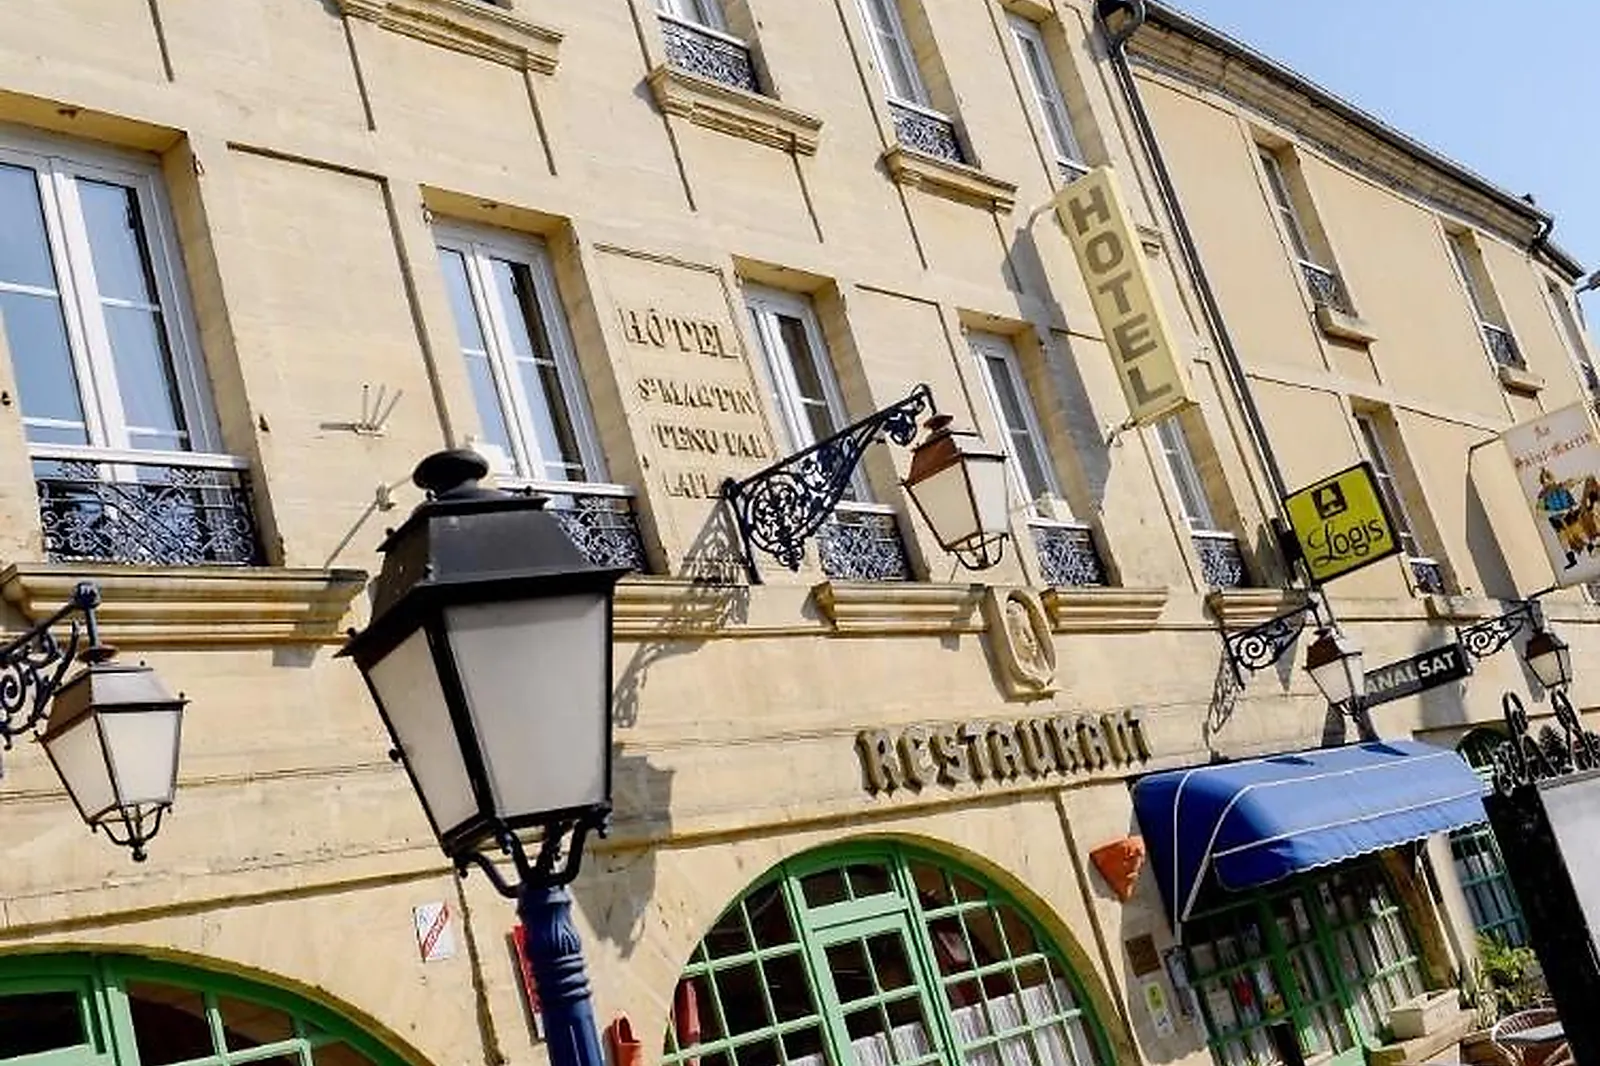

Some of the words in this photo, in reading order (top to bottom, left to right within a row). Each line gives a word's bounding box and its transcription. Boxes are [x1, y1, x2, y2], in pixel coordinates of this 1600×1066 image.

[1069, 185, 1173, 406] HOTEL
[1307, 519, 1385, 568] Logis
[1363, 651, 1455, 695] ANALSAT
[855, 709, 1152, 798] RESTAURANT
